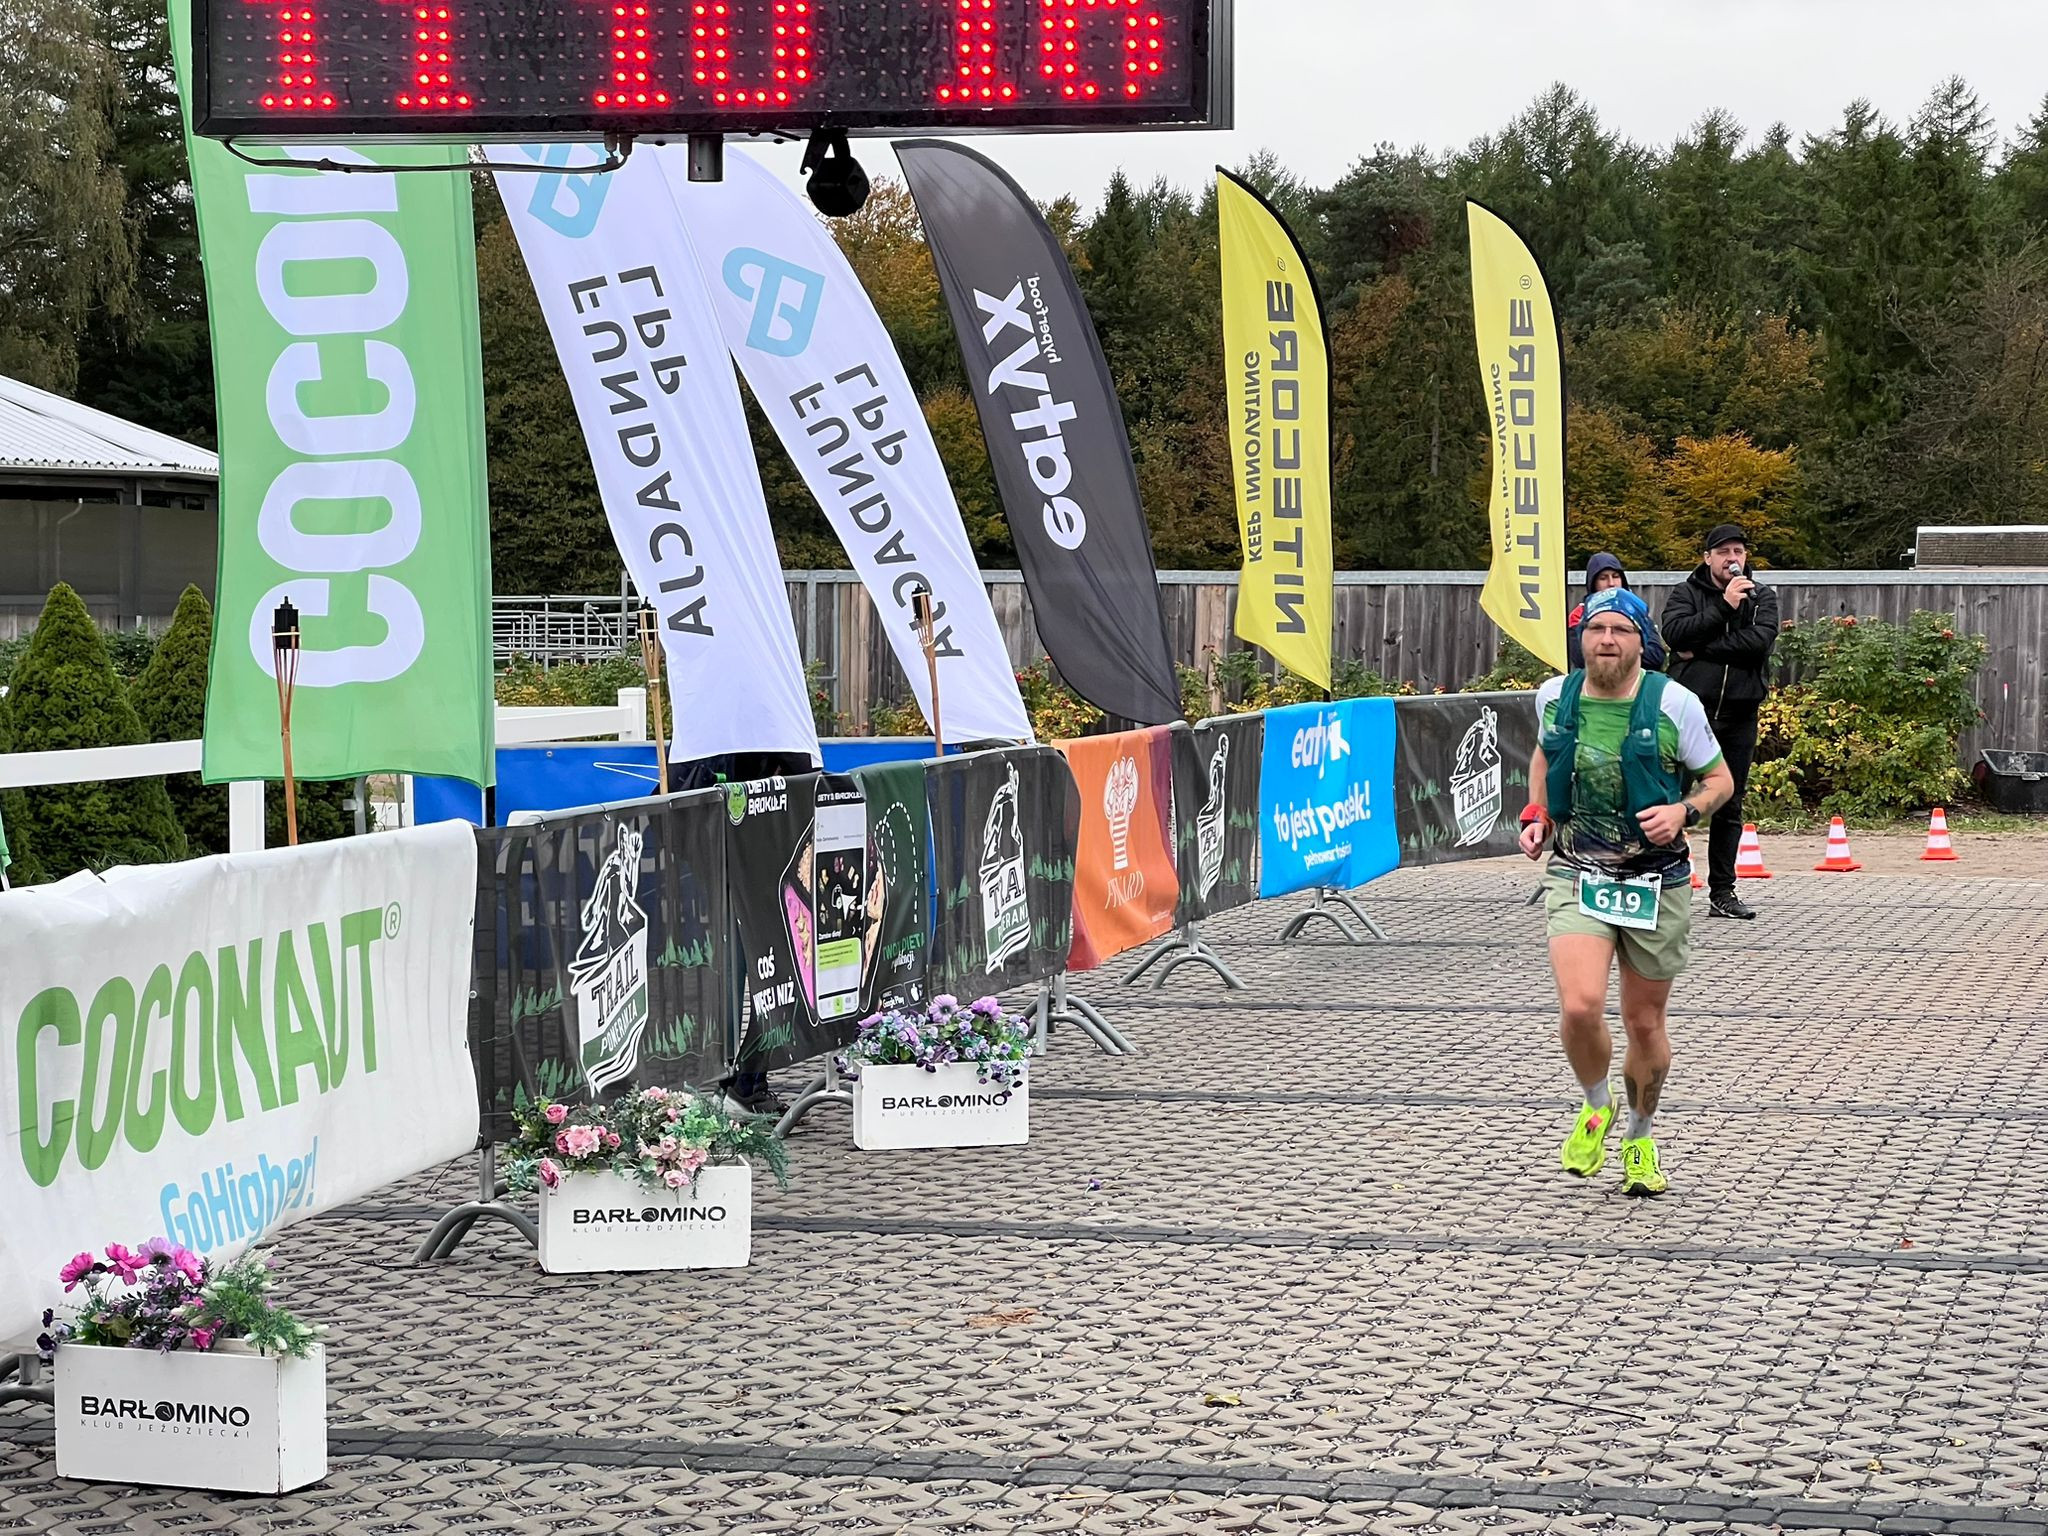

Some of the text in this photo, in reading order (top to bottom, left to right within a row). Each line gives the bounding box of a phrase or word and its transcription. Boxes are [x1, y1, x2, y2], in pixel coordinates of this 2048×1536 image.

[1459, 770, 1496, 812] TRAIL
[1274, 803, 1289, 842] to
[1289, 797, 1319, 852] jest
[1594, 888, 1641, 914] 619
[757, 946, 776, 980] COŚ
[591, 943, 639, 1028] TRAIL
[776, 975, 796, 1007] NIŻ
[572, 1206, 727, 1224] BARŁOMINO
[572, 1225, 613, 1233] KLUB
[80, 1396, 250, 1427] BARŁOMINO
[80, 1419, 124, 1430] KLUB
